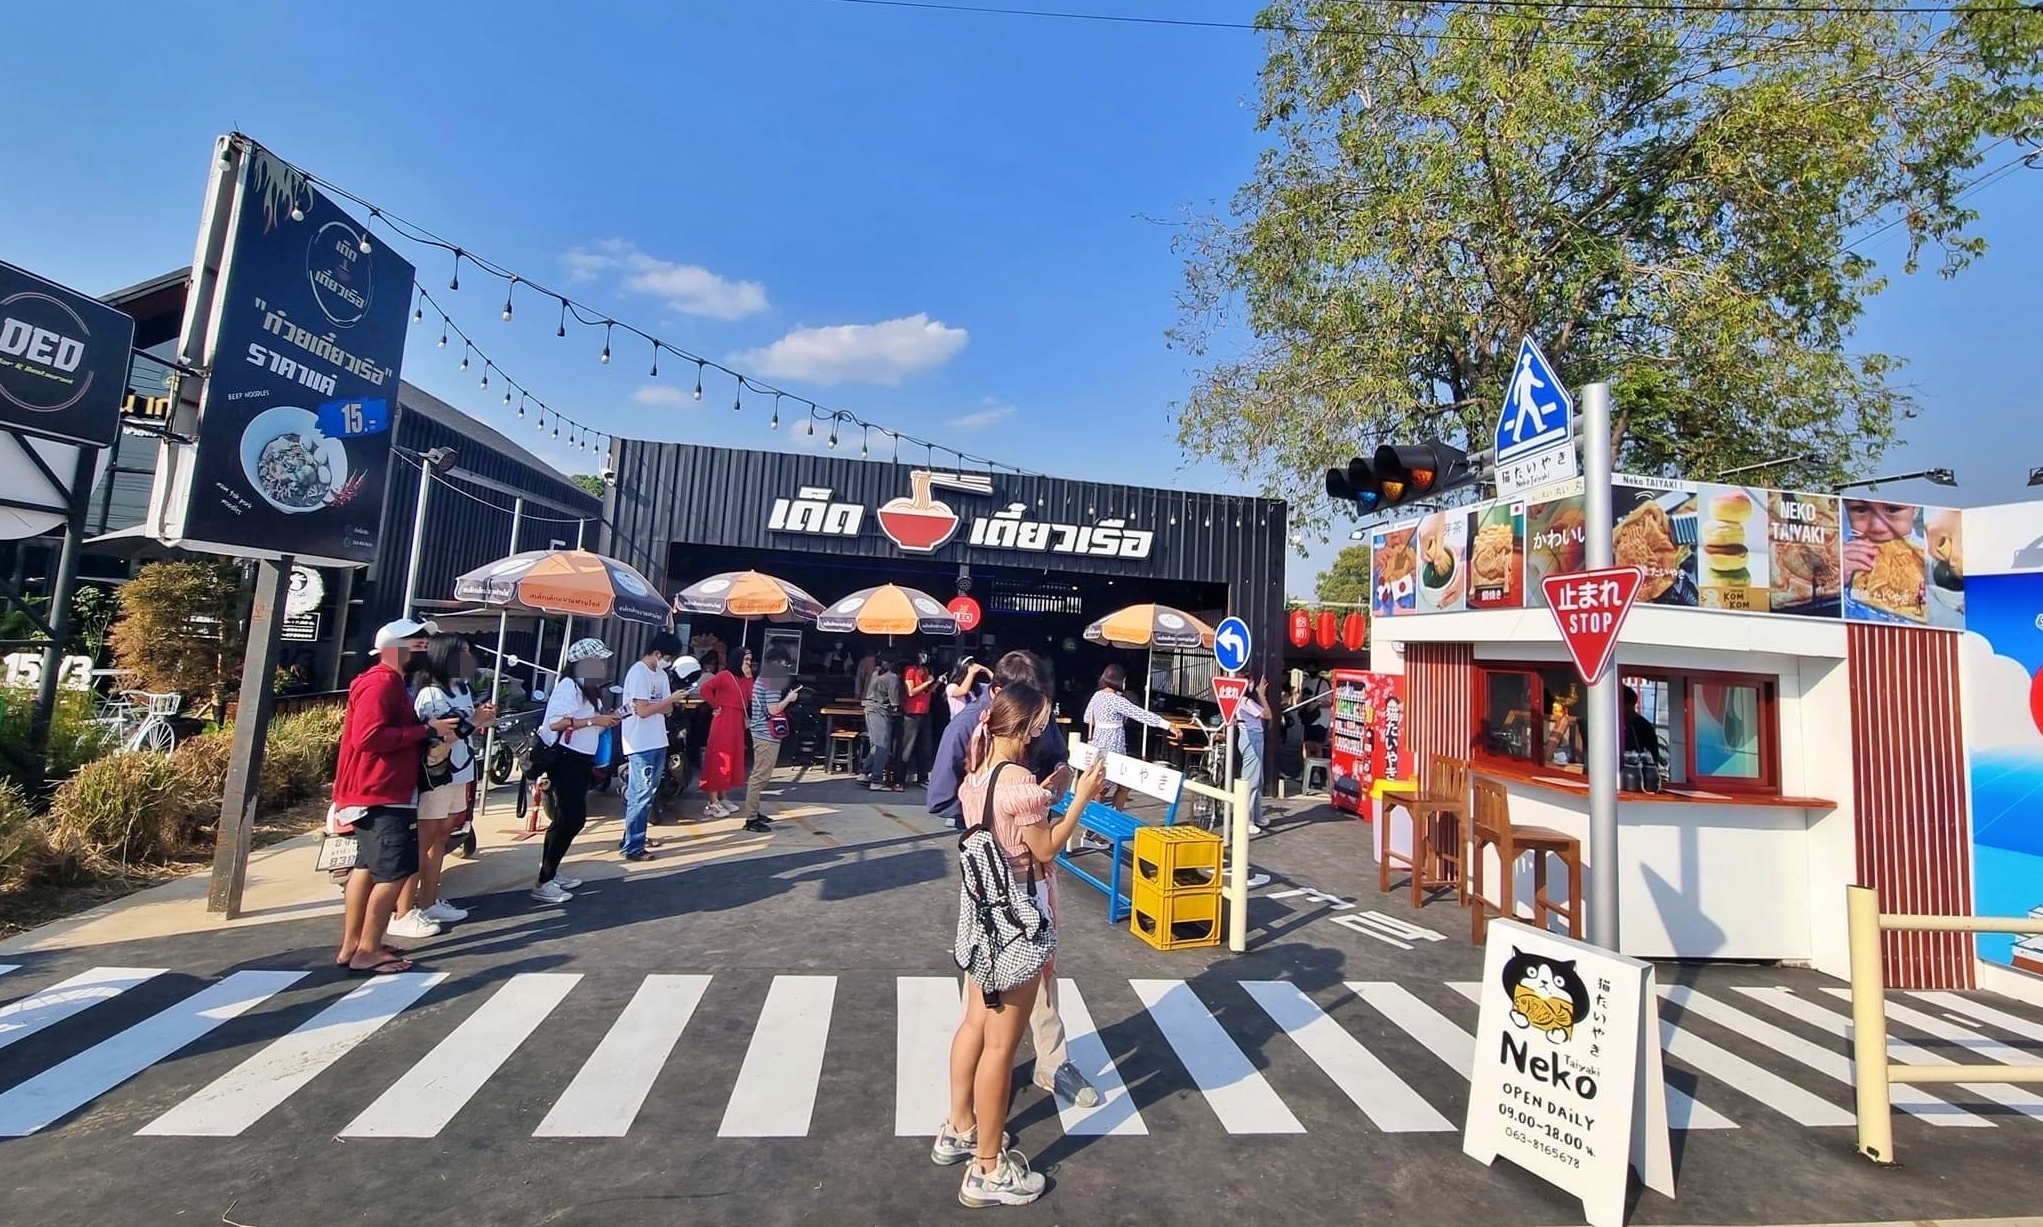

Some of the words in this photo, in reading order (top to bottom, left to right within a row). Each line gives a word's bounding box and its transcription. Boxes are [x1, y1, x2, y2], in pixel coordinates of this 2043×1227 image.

[0, 318, 85, 372] DED
[1622, 476, 1644, 485] Neko
[1646, 478, 1678, 490] TAIYAKI
[1780, 501, 1816, 521] NEKO
[1771, 523, 1825, 544] TAIYAKI
[1558, 580, 1622, 610] 止まれ
[1724, 592, 1744, 602] KOM
[1730, 601, 1750, 610] KOM
[1569, 612, 1612, 634] STOP
[1219, 685, 1239, 700] 止まれ
[1590, 977, 1611, 1058] 猫たいやき
[1499, 1030, 1598, 1100] Neko
[1563, 1054, 1601, 1077] Taiyaki
[1502, 1082, 1543, 1109] OPEN
[1498, 1103, 1583, 1150] 09.00-18.00
[1504, 1126, 1581, 1169] 063-8165678
